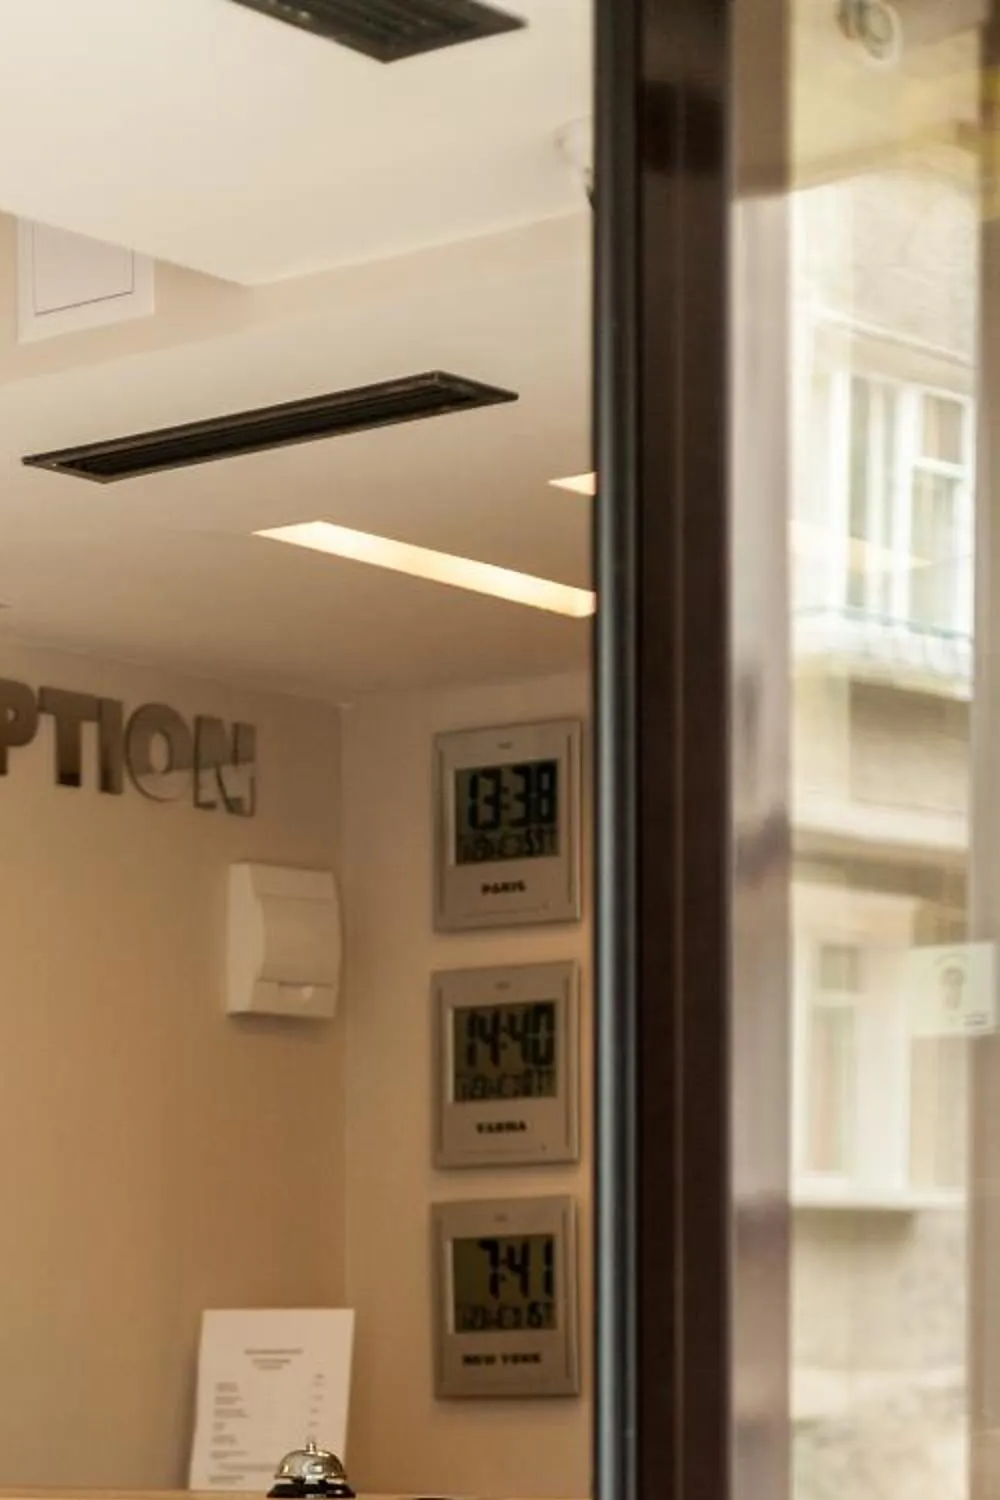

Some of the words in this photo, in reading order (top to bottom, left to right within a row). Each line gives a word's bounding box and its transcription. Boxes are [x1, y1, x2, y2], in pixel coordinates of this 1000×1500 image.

[481, 880, 526, 895] PARIS
[467, 1002, 555, 1067] 14:40
[477, 1237, 554, 1300] 7:41
[462, 1354, 497, 1367] NEW
[501, 1352, 541, 1366] YORK
